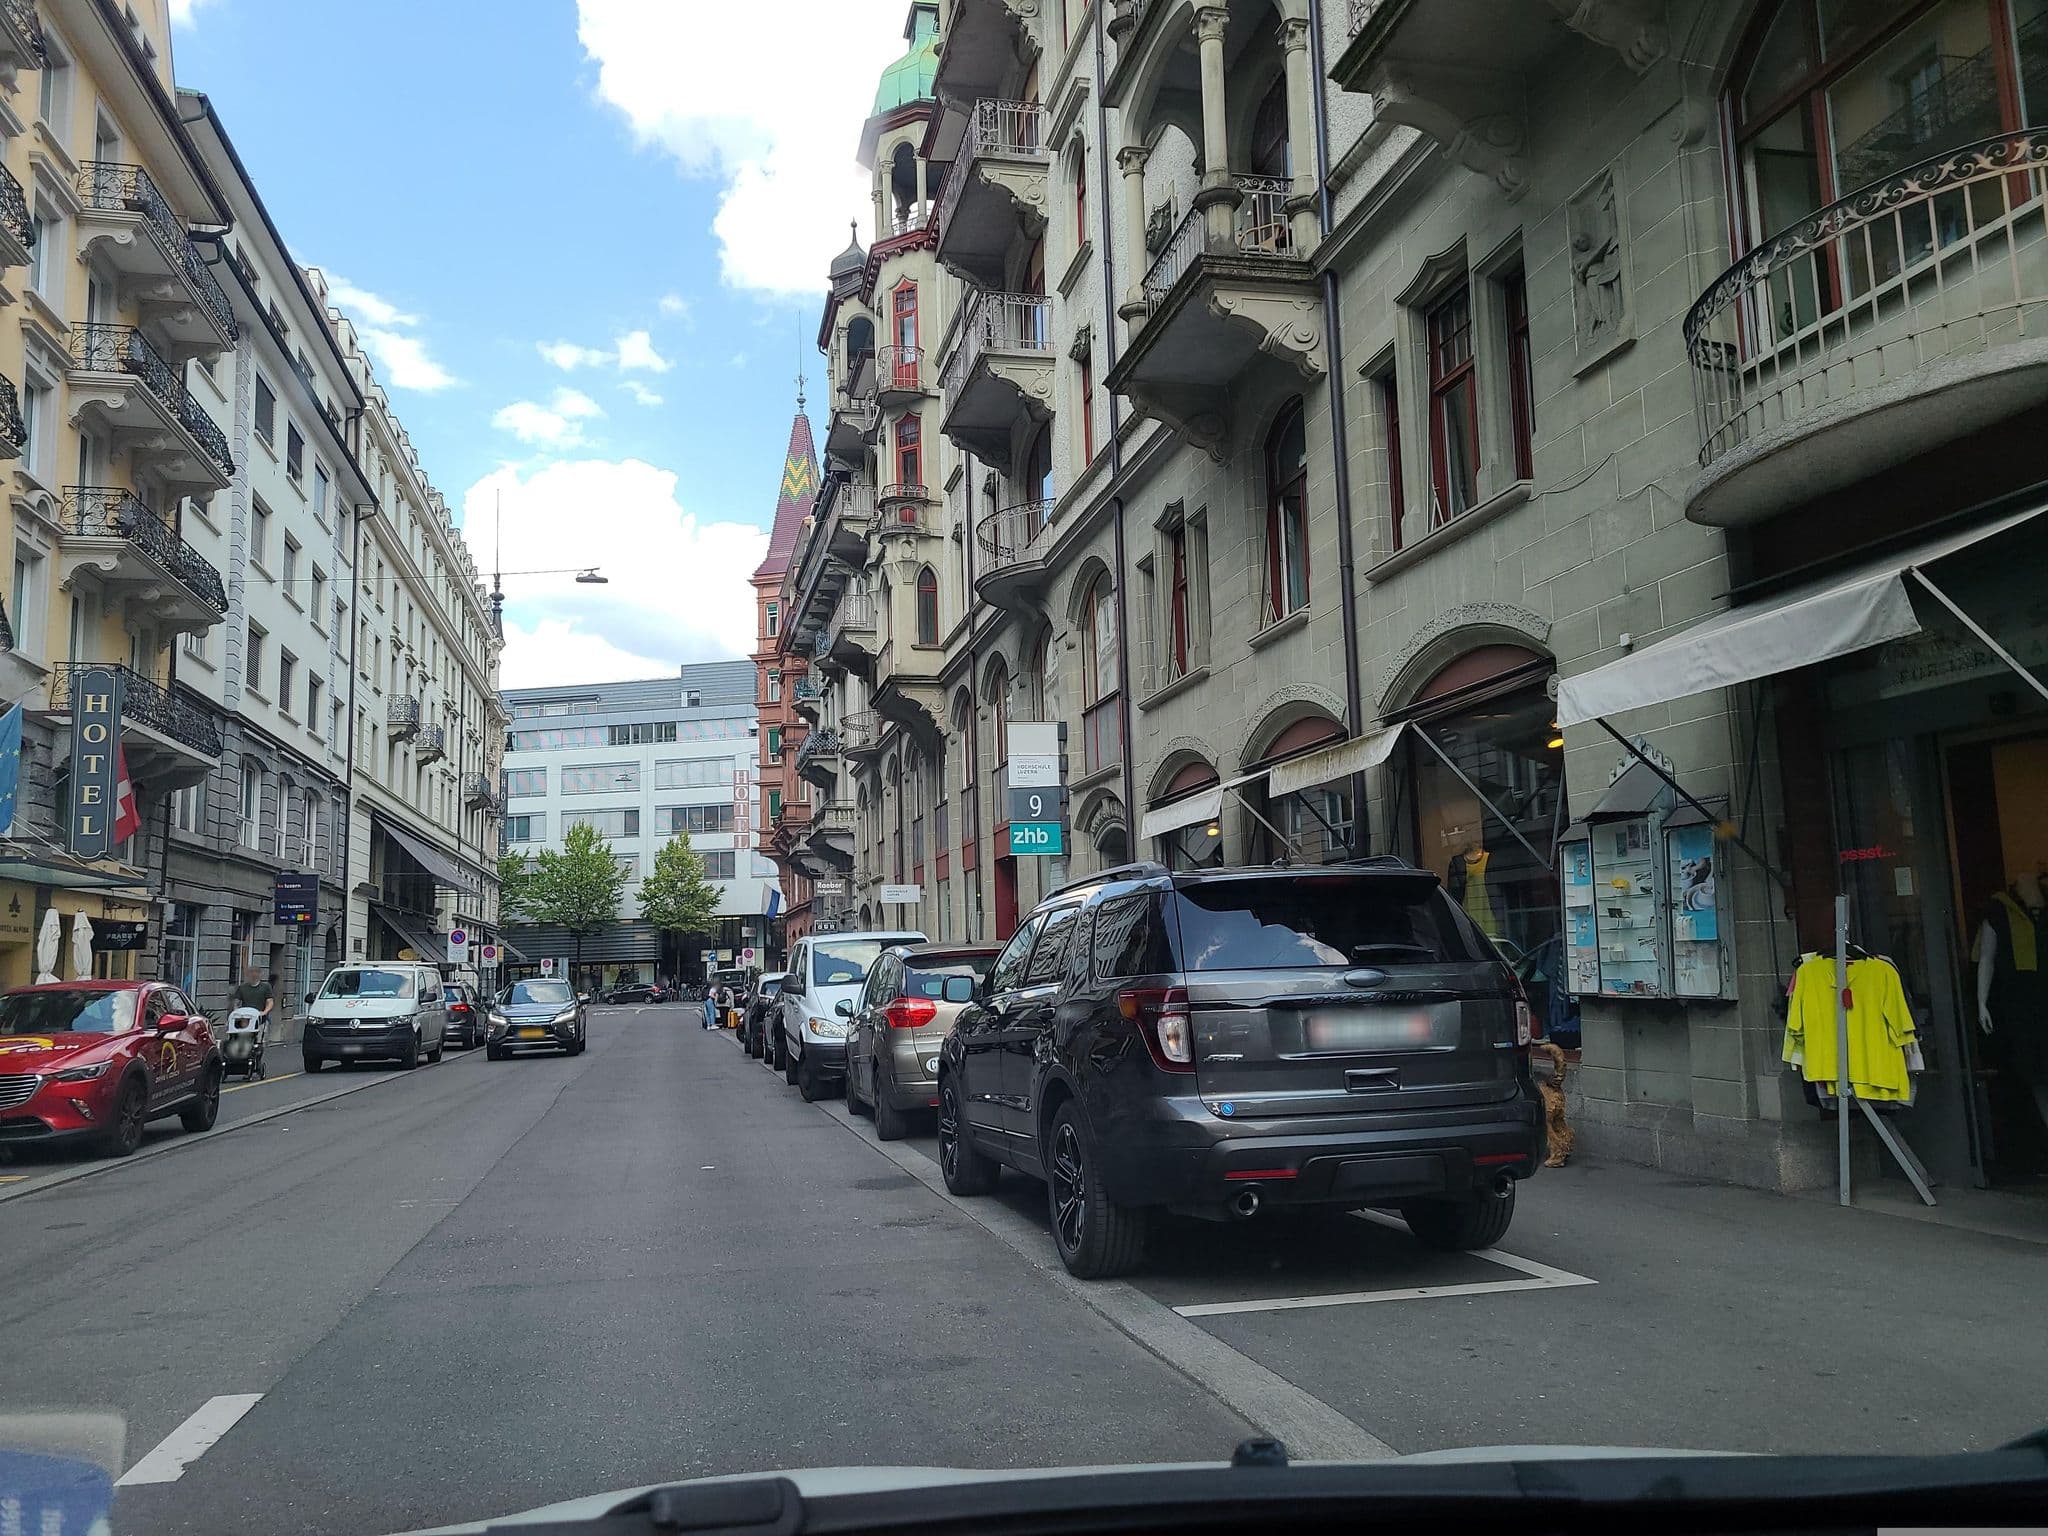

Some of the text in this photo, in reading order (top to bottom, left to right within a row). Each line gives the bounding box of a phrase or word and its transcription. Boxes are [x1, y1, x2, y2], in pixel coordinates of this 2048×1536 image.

[79, 693, 110, 836] HOTEL
[734, 770, 748, 849] HOTEL
[1029, 794, 1043, 817] 9
[1013, 827, 1049, 844] zhb
[15, 1044, 80, 1053] COACH
